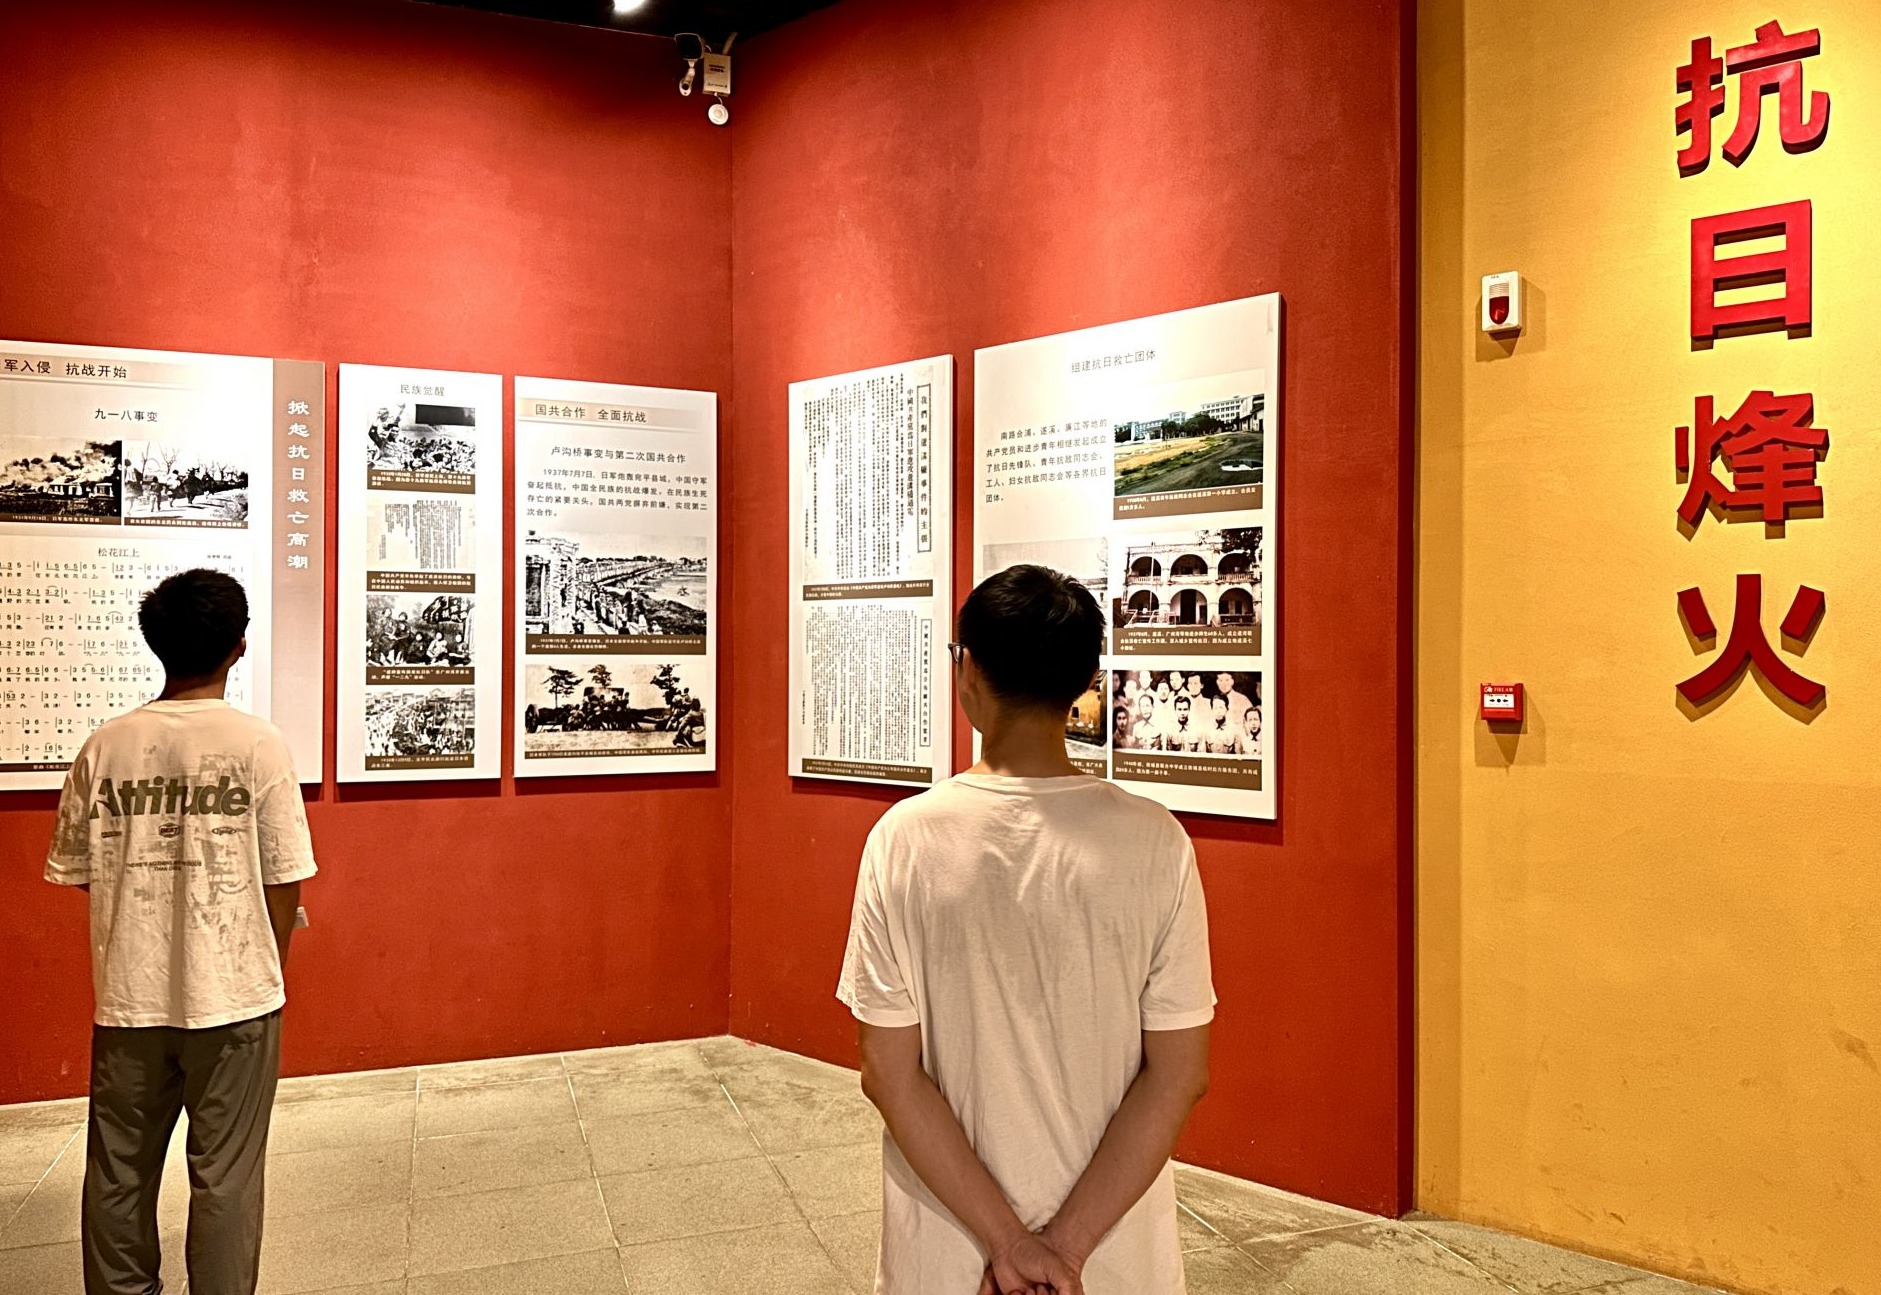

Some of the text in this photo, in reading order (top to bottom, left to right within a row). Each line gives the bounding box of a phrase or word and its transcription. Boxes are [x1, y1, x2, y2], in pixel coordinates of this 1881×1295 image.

[4, 359, 127, 379] 军入侵 抗战开始
[1071, 349, 1157, 374] 组建抗日救亡团体
[1676, 20, 1829, 720] 抗日烽火
[400, 384, 445, 397] 民族觉醒
[95, 407, 158, 423] 九一八事变
[535, 403, 647, 423] 国共合作 全面抗战
[551, 446, 686, 464] 卢沟桥事变与第二次国共合作
[986, 434, 1107, 458] 共产党员和进步青年相继发起成立
[287, 400, 310, 570] 掀起抗日救亡高潮
[98, 547, 140, 558] 松花江上
[89, 776, 251, 819] Attitude
